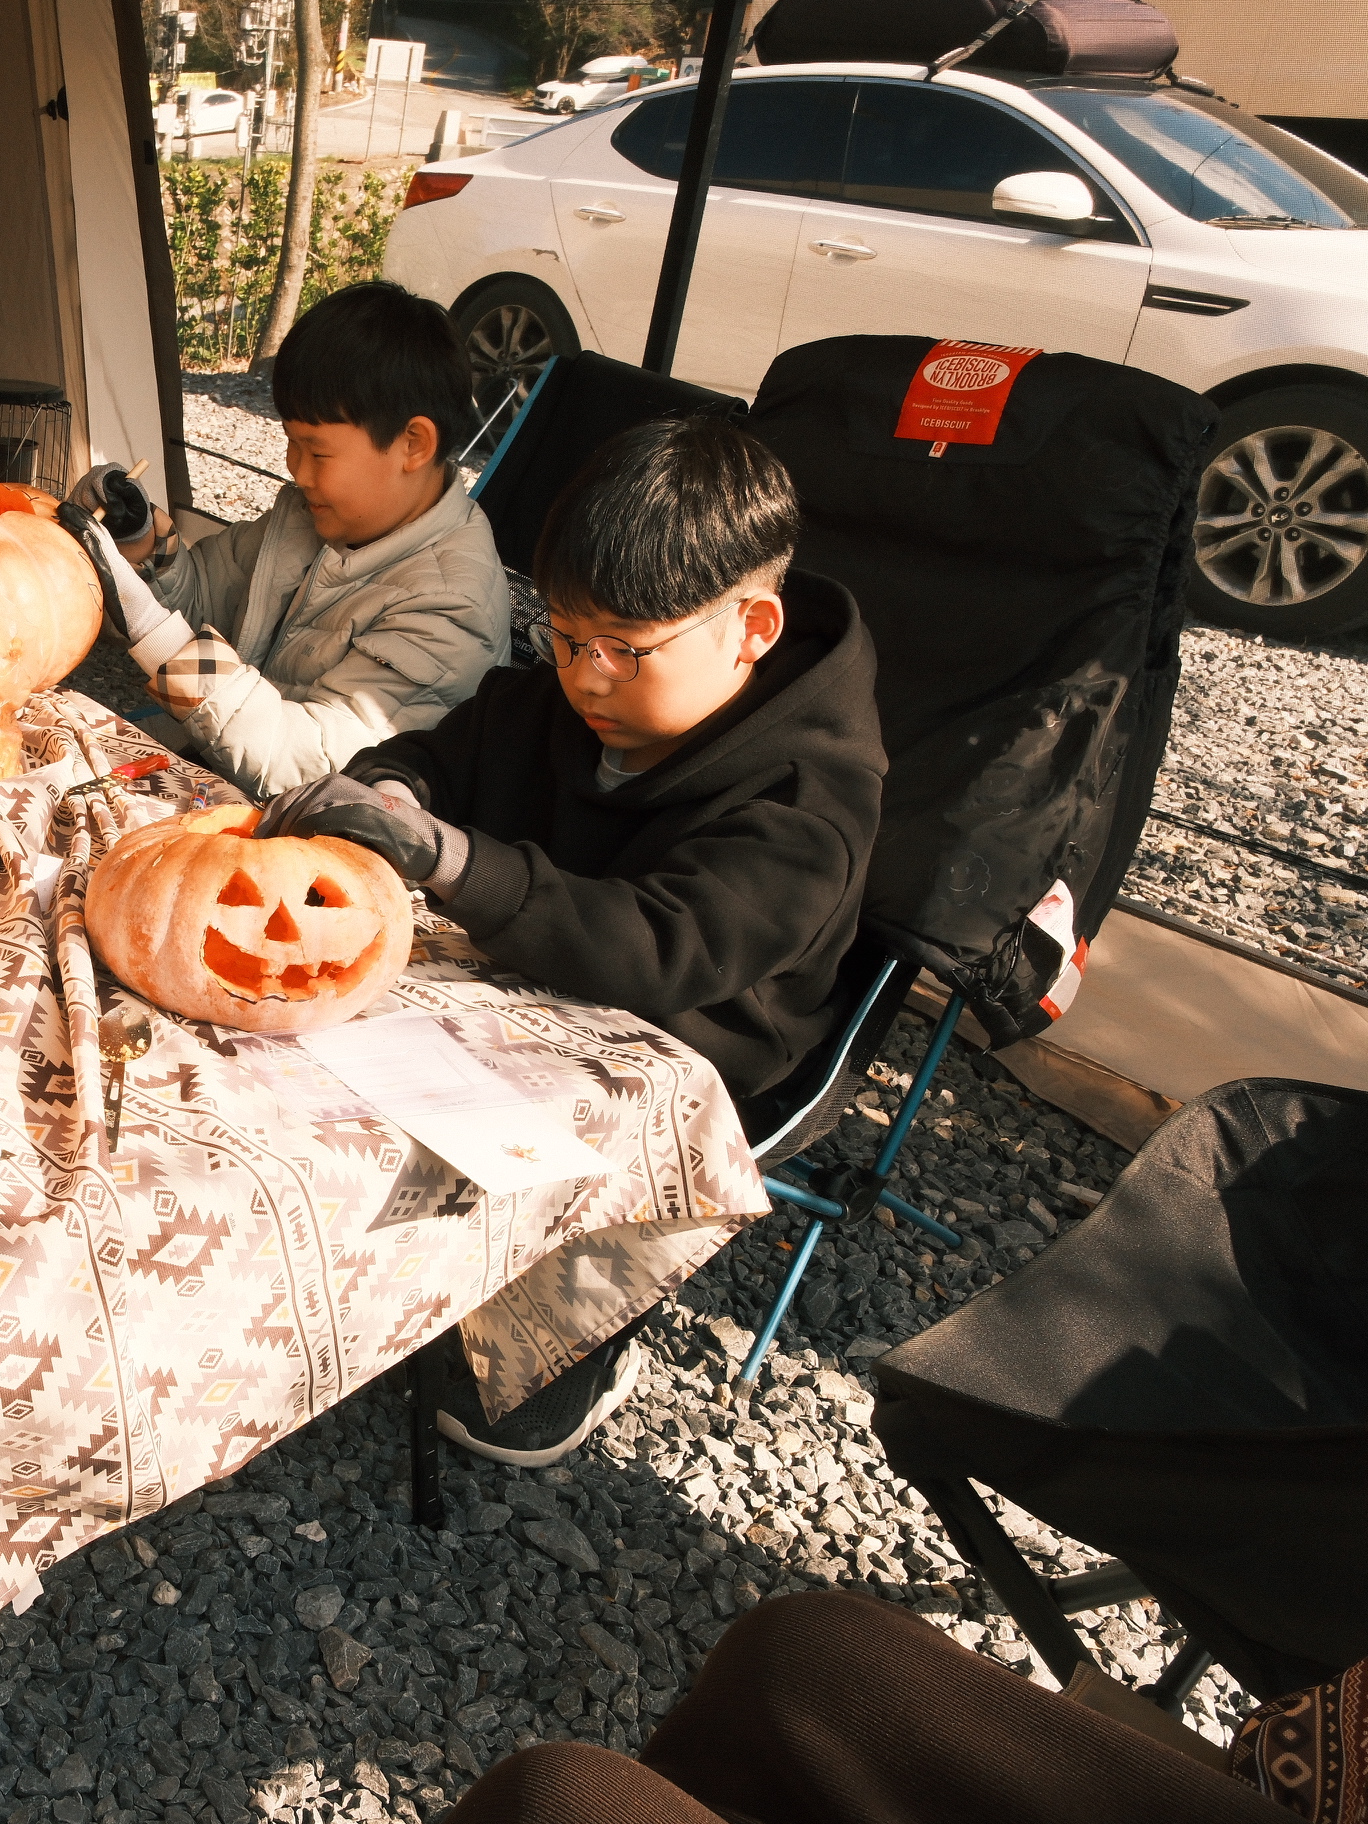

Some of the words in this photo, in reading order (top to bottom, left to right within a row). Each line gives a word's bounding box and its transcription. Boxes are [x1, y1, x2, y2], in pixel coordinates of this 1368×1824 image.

[934, 357, 1003, 375] ICEBISCUIT
[929, 370, 998, 389] BROOKLYN
[920, 418, 971, 429] ICEBISCUIT
